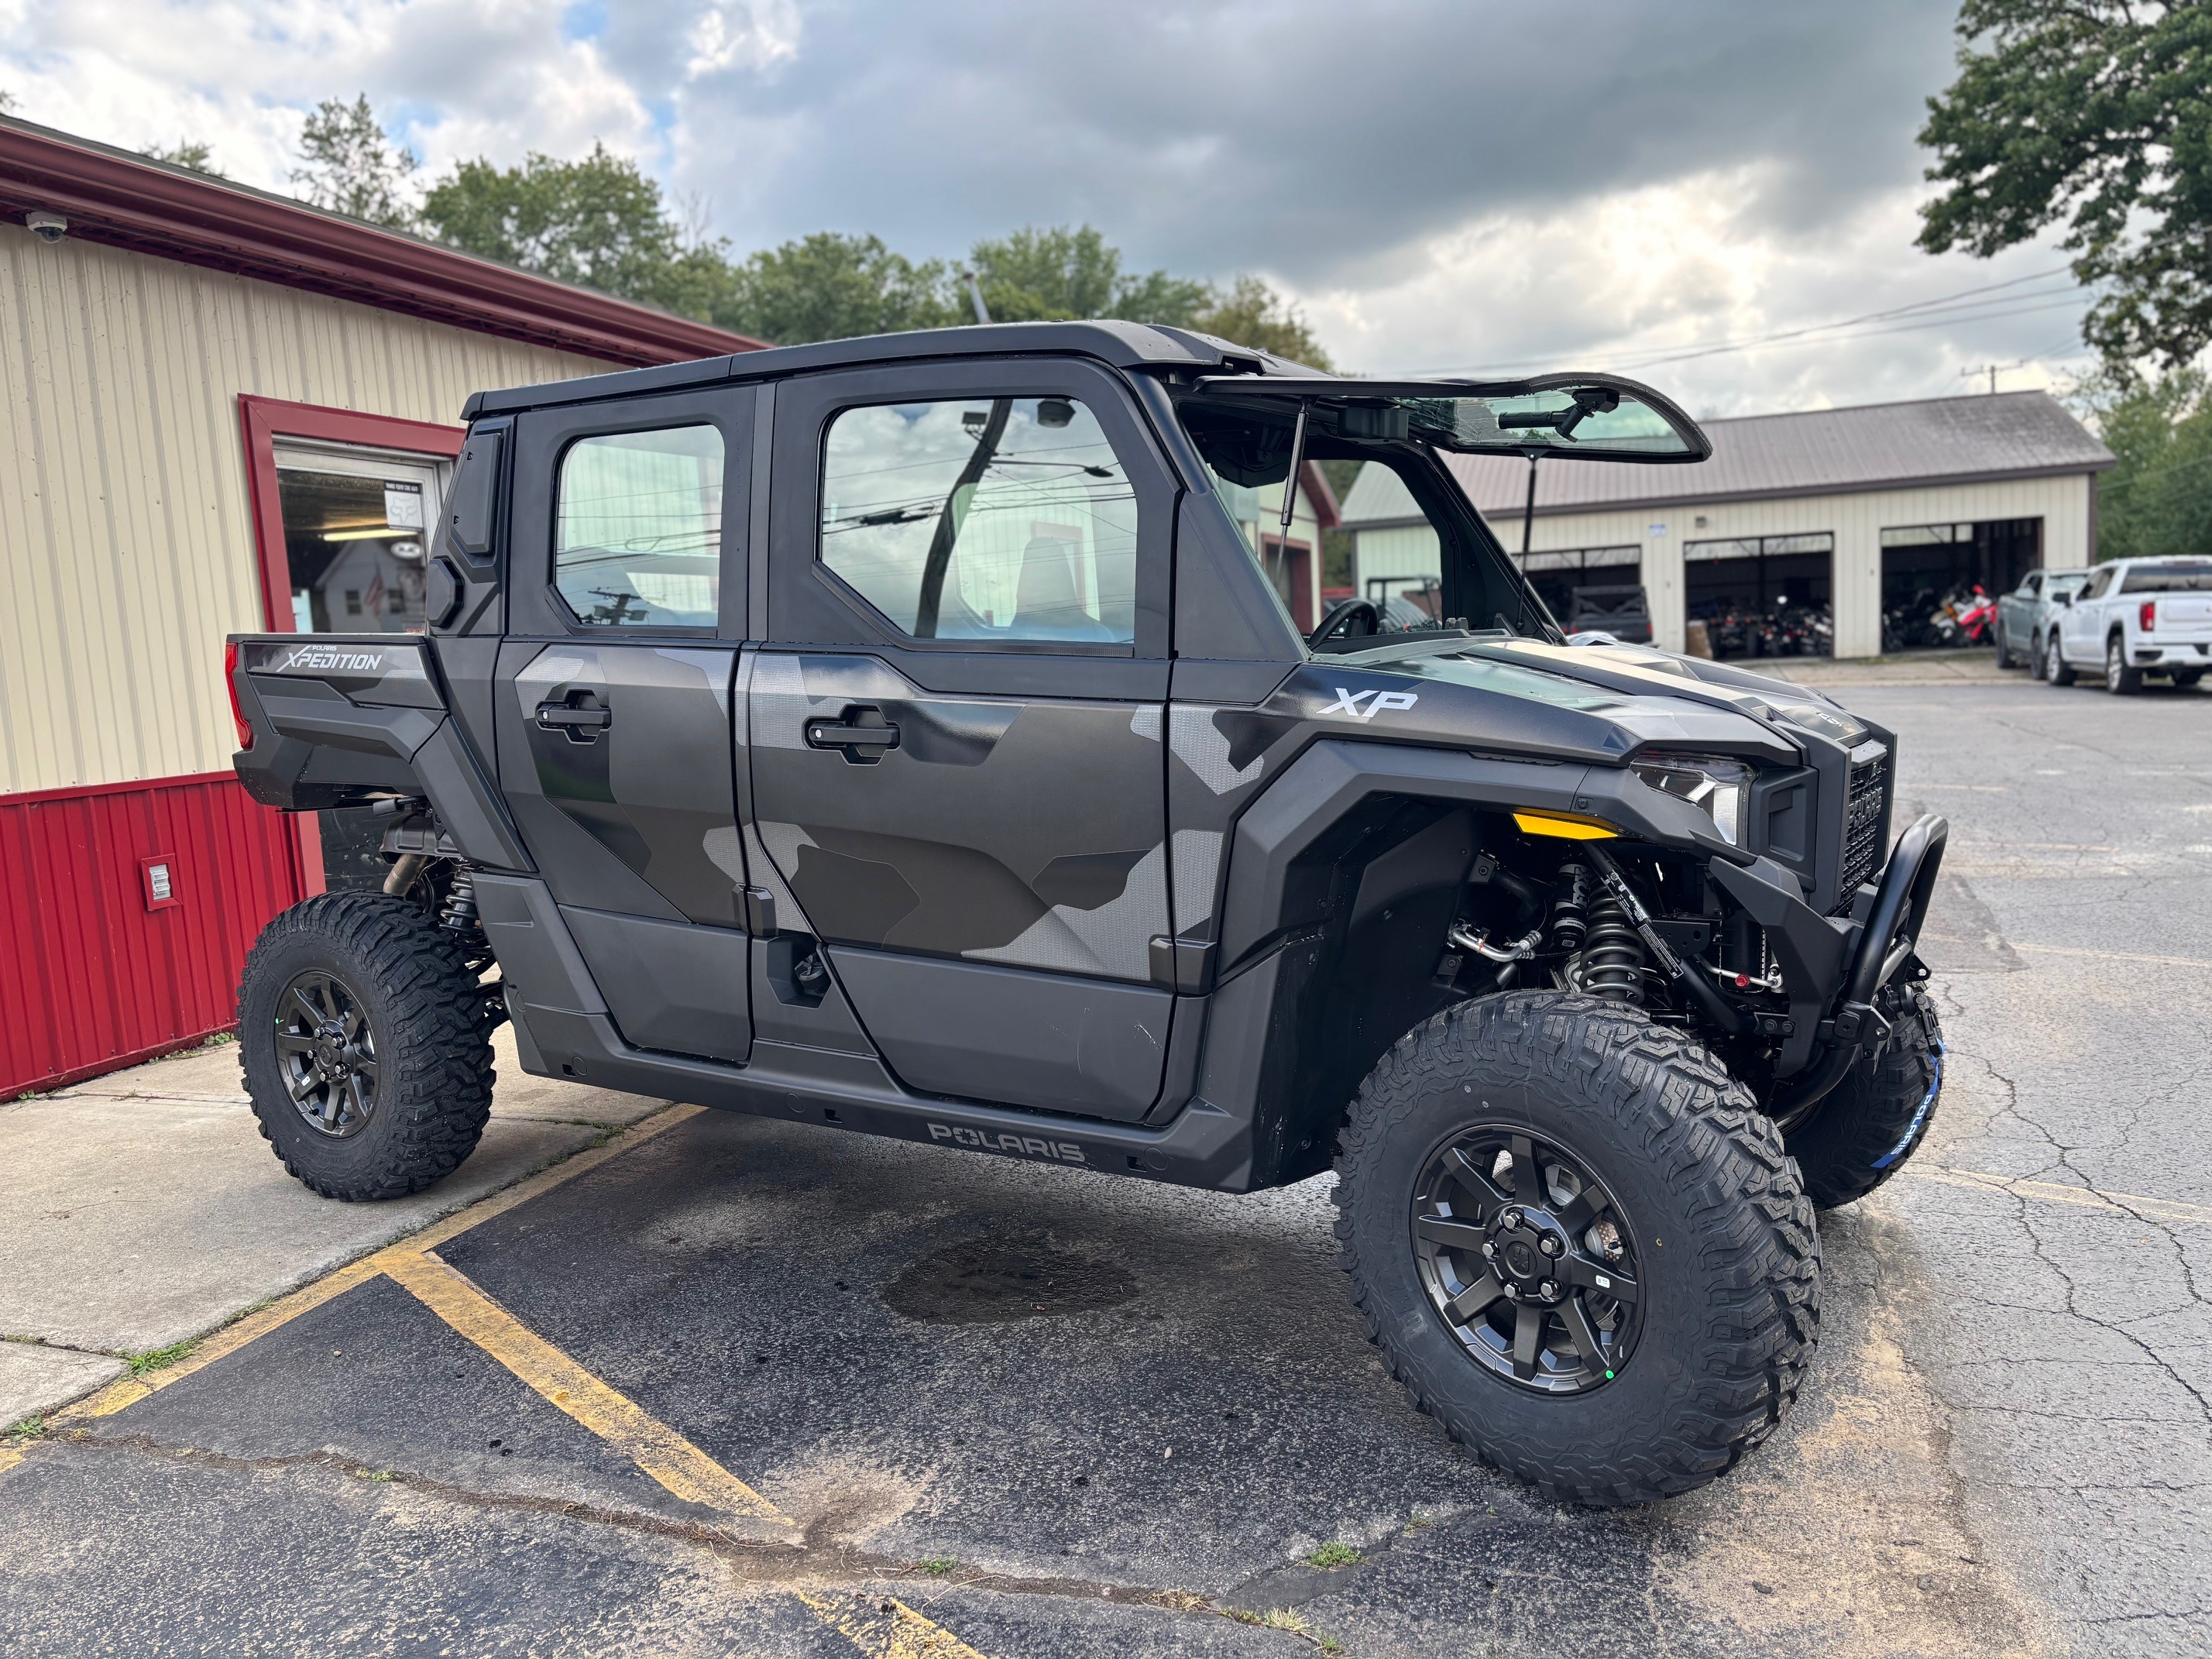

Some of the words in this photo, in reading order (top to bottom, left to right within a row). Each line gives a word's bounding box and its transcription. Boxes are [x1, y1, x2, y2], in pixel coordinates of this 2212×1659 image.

[276, 645, 383, 673] XPEDITION
[1315, 687, 1419, 718] XP
[1890, 1094, 1933, 1155] POLARIS
[926, 1123, 1086, 1163] POLARIS
